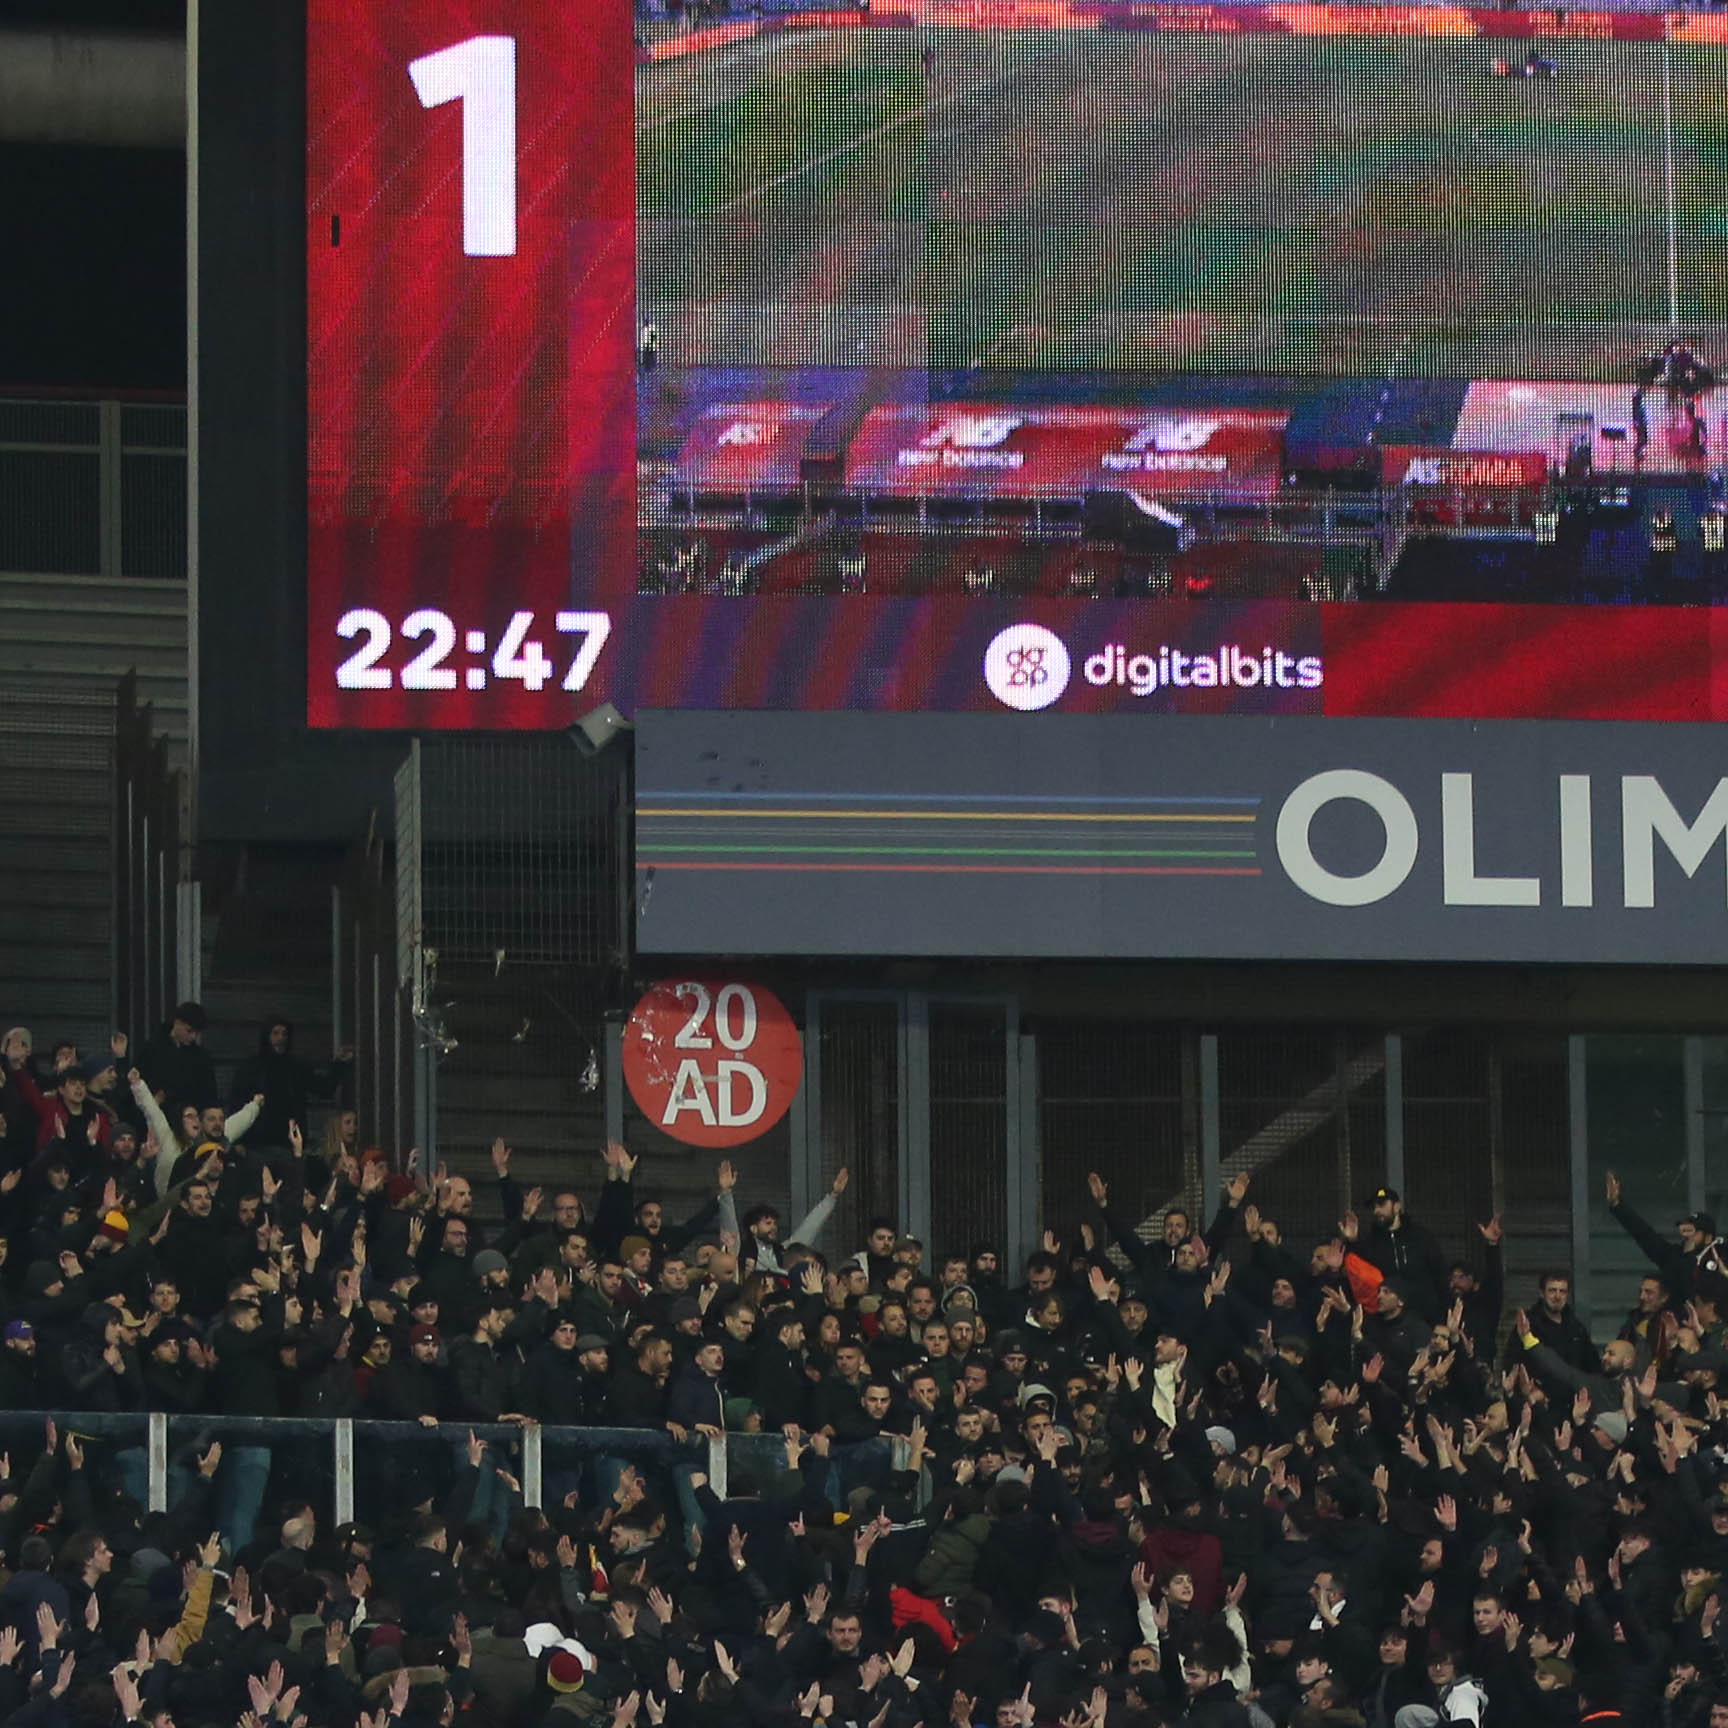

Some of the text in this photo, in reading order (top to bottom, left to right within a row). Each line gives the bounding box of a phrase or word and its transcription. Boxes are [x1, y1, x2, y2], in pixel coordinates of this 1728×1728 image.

[407, 34, 517, 257] 1
[336, 607, 612, 691] 22:47
[1084, 643, 1323, 695] digitalbits
[675, 982, 756, 1050] 20
[662, 1059, 768, 1126] AD
